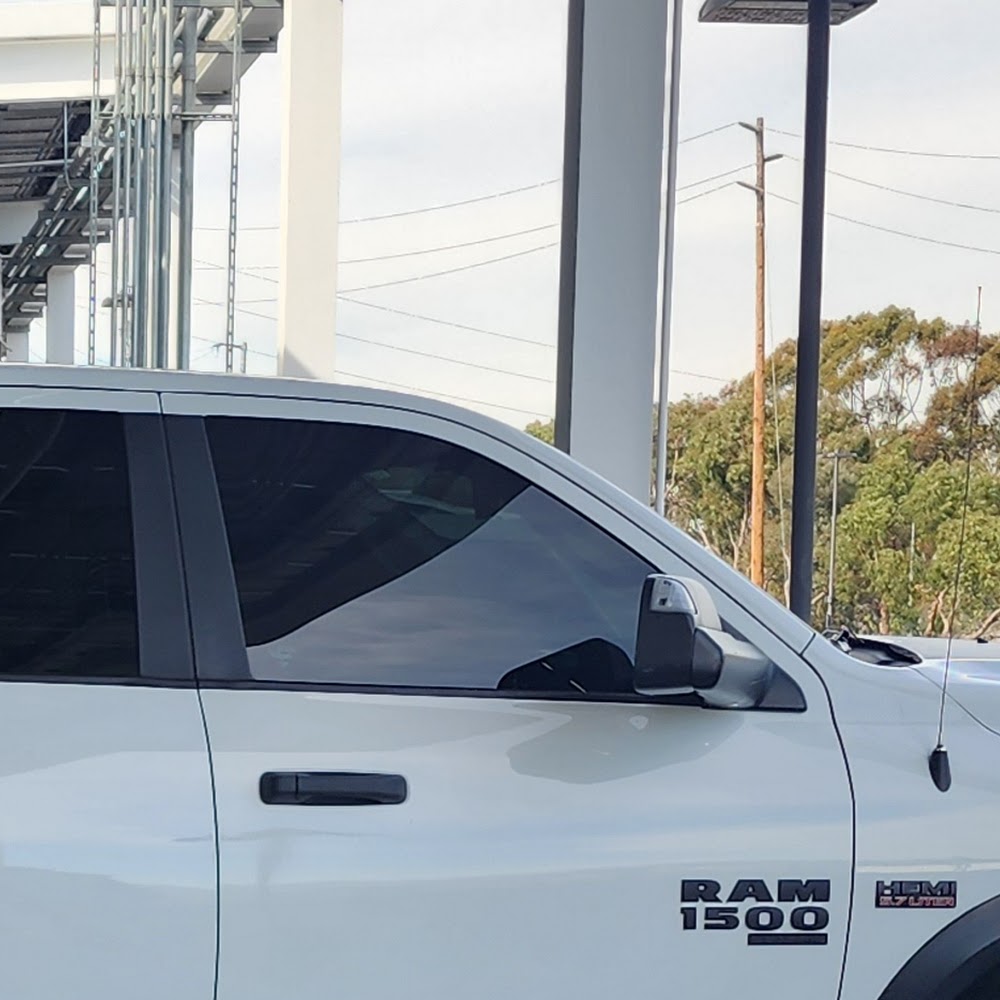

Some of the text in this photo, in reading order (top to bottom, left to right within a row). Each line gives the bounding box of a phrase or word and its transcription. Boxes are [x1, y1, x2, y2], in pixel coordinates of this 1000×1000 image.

[681, 879, 831, 902] RAM
[876, 881, 957, 896] HEMI
[680, 906, 830, 930] 1500
